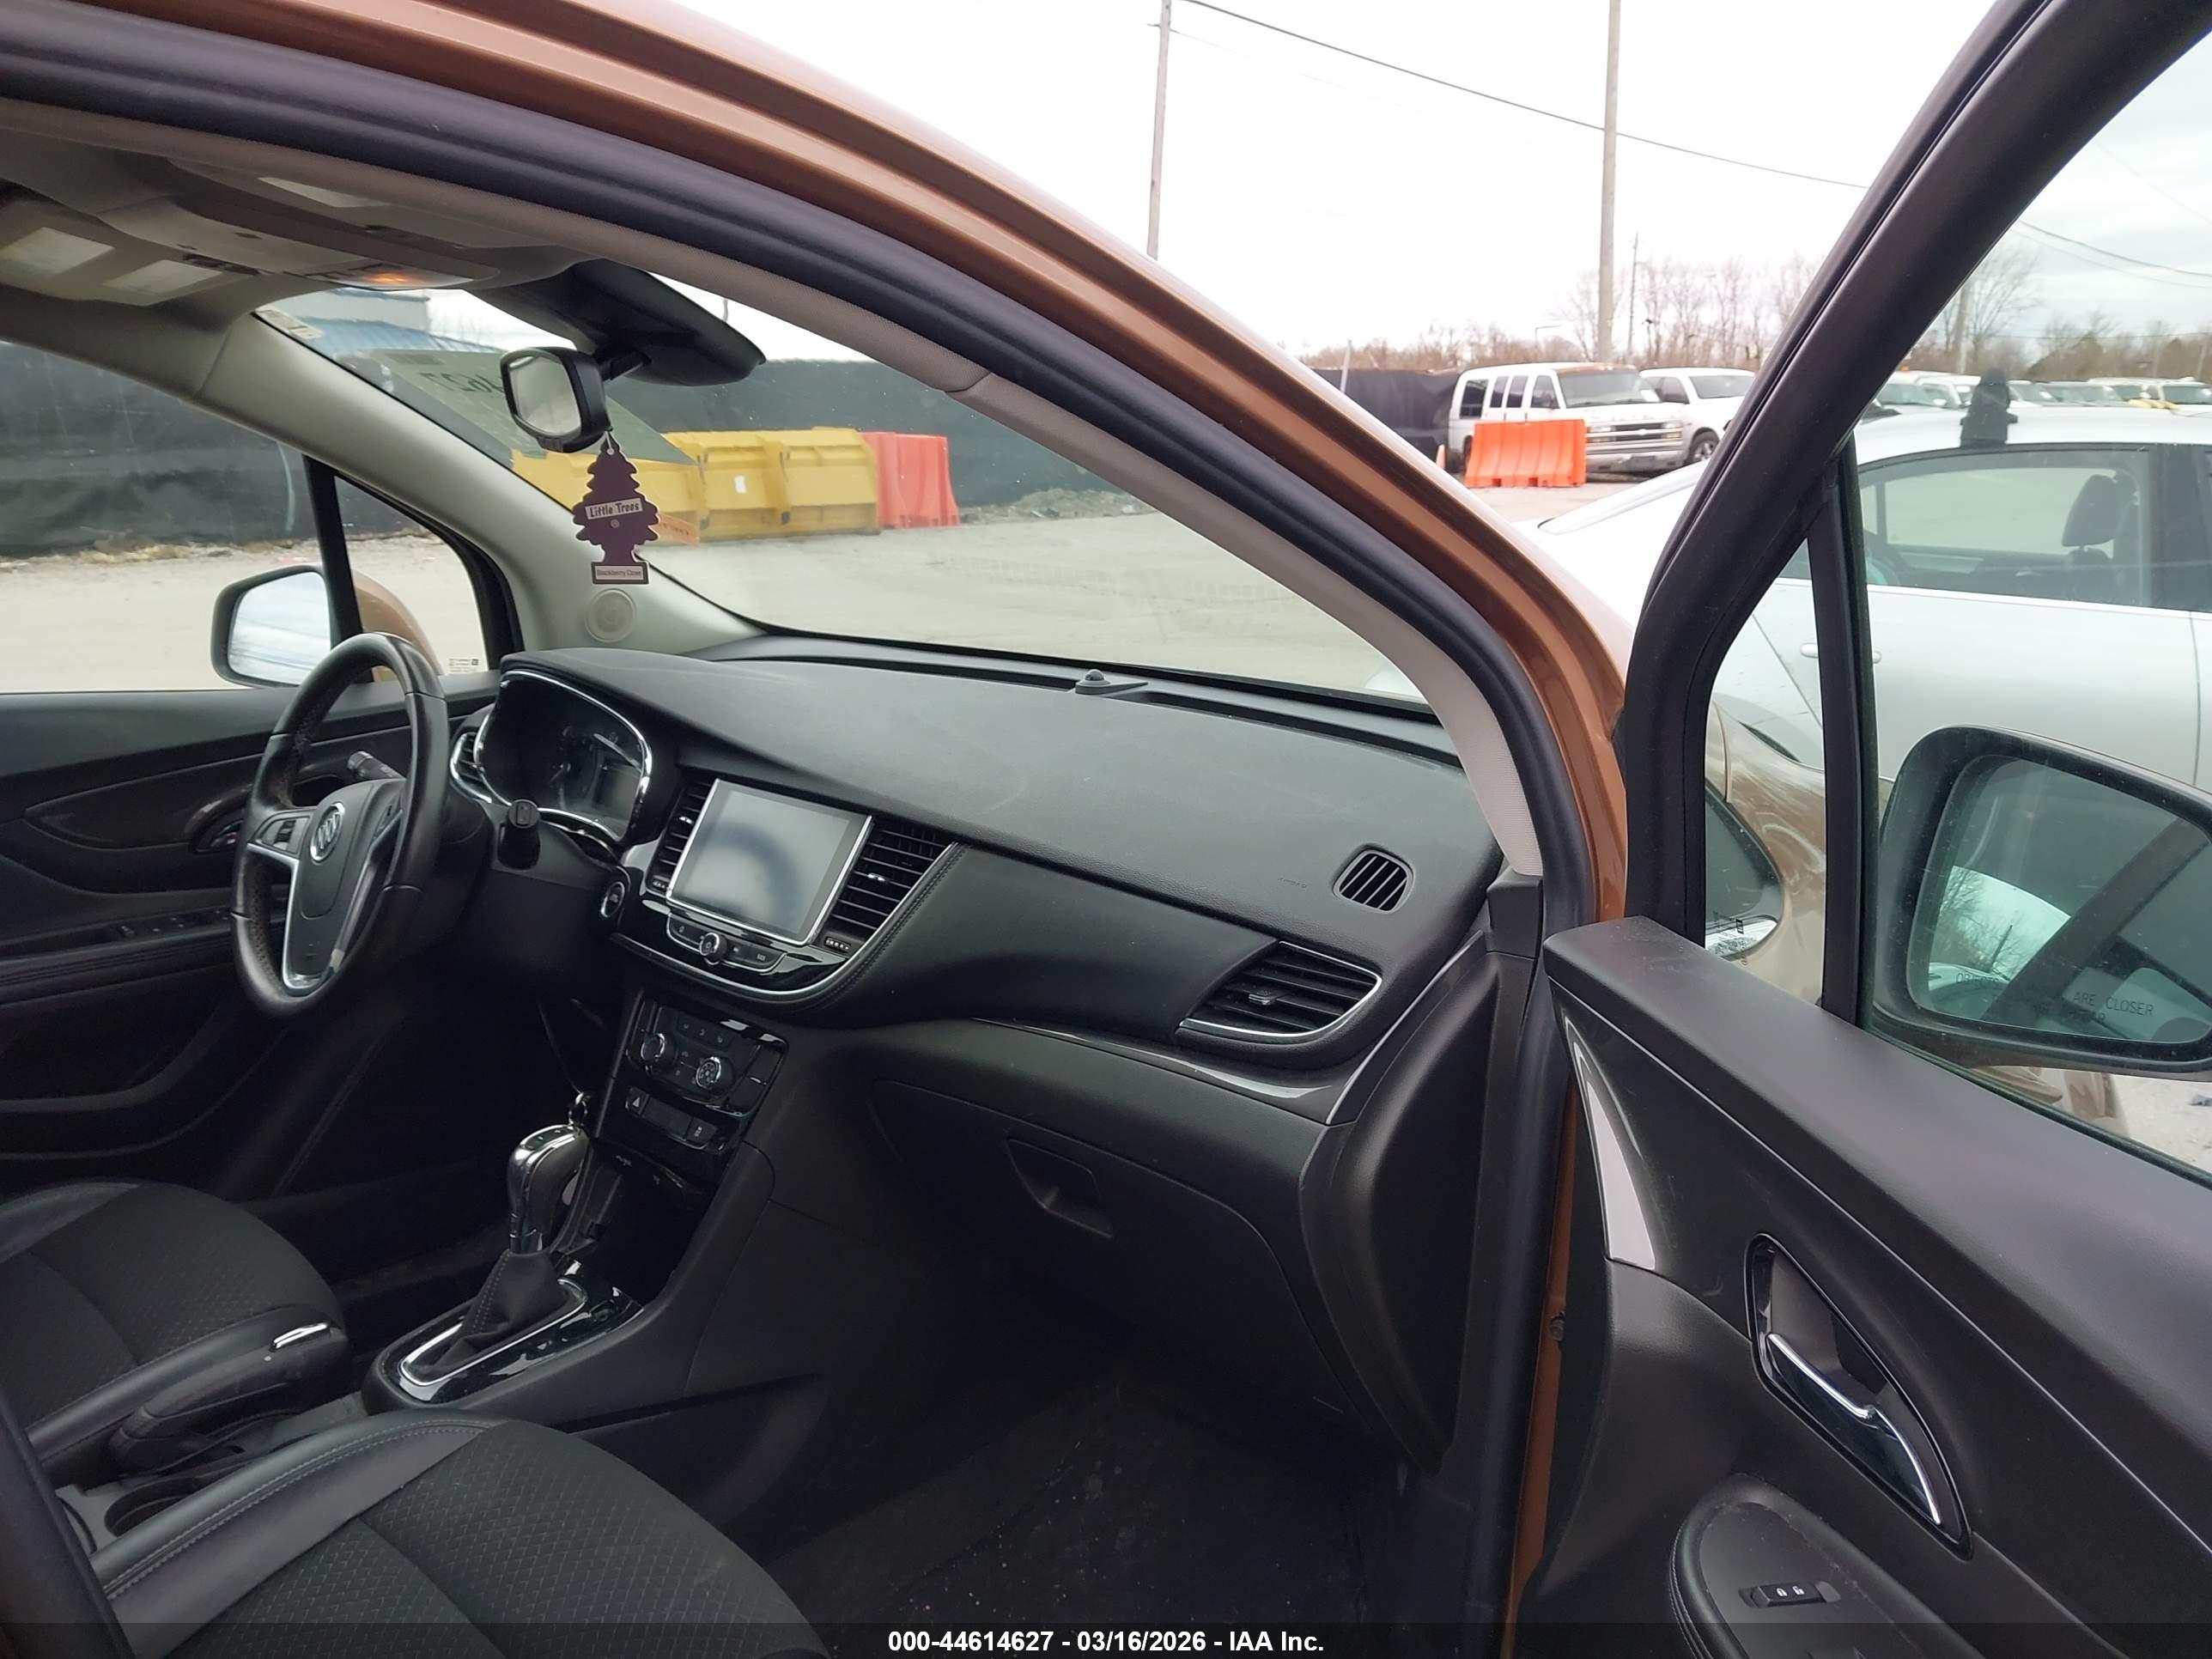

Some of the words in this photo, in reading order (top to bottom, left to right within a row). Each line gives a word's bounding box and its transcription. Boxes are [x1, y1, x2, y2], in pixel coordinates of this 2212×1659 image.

[590, 505, 613, 518] Little
[615, 502, 640, 514] Trees
[2074, 992, 2096, 1006] ARE
[2106, 995, 2154, 1017] CLOSER
